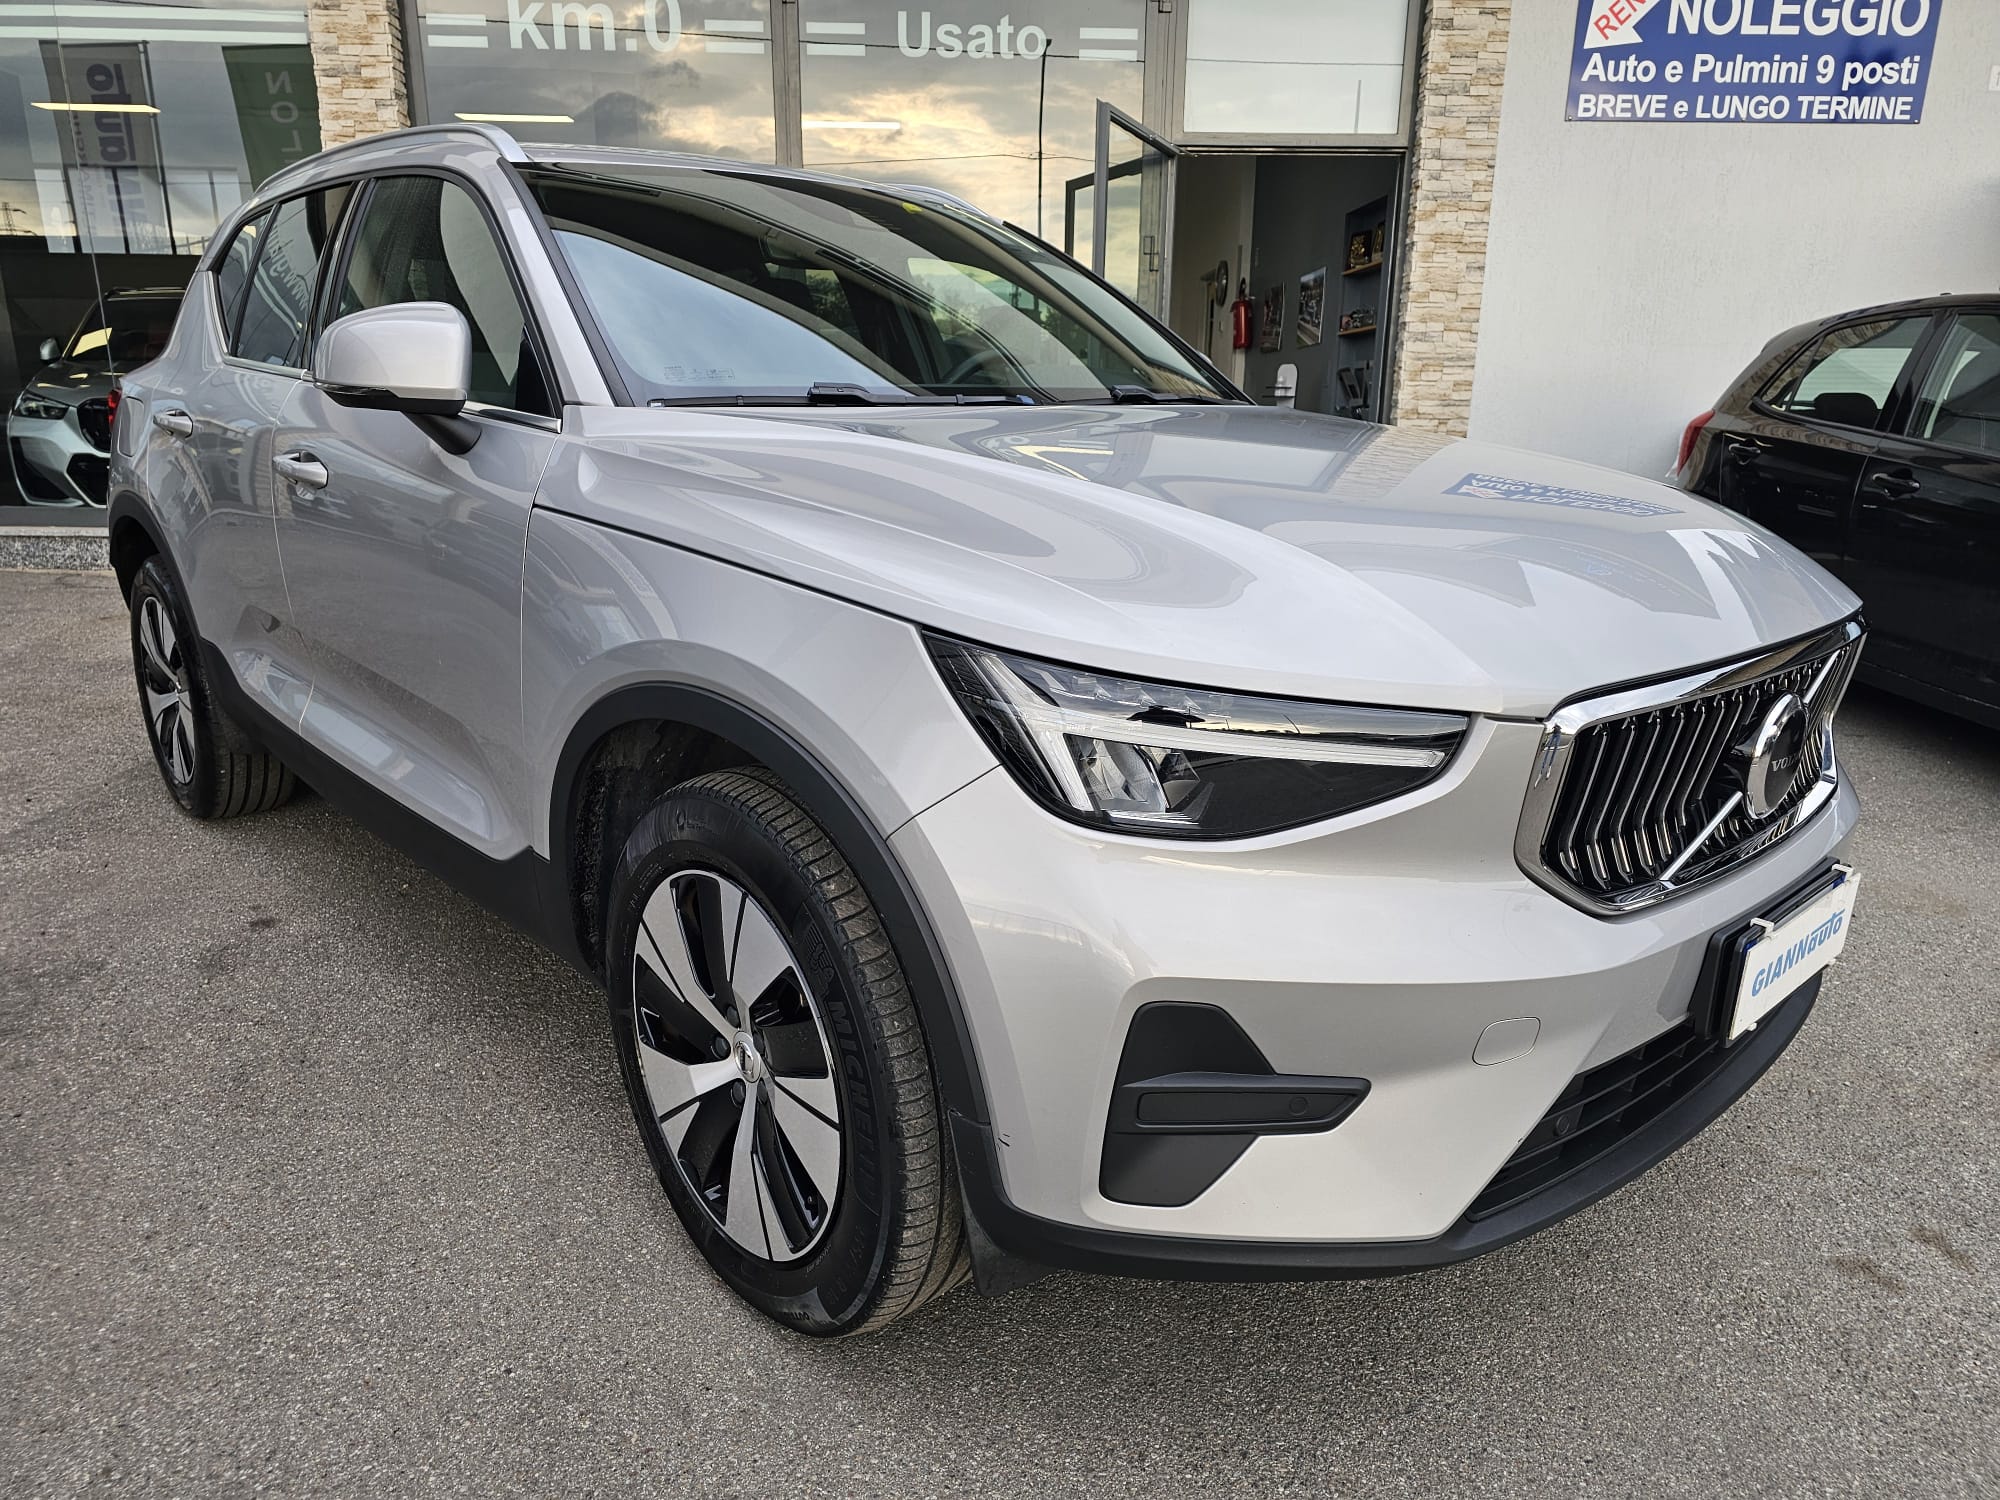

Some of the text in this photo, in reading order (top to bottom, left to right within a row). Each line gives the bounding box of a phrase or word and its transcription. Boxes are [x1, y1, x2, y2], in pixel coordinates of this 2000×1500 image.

[507, 0, 682, 51] km.0
[896, 10, 1047, 60] Usato
[1666, 0, 1930, 36] NOLEGGIO
[1581, 53, 1920, 91] Auto e Pulmini 9 posti
[1577, 94, 1913, 121] BREVE e LUNGO TERMINE
